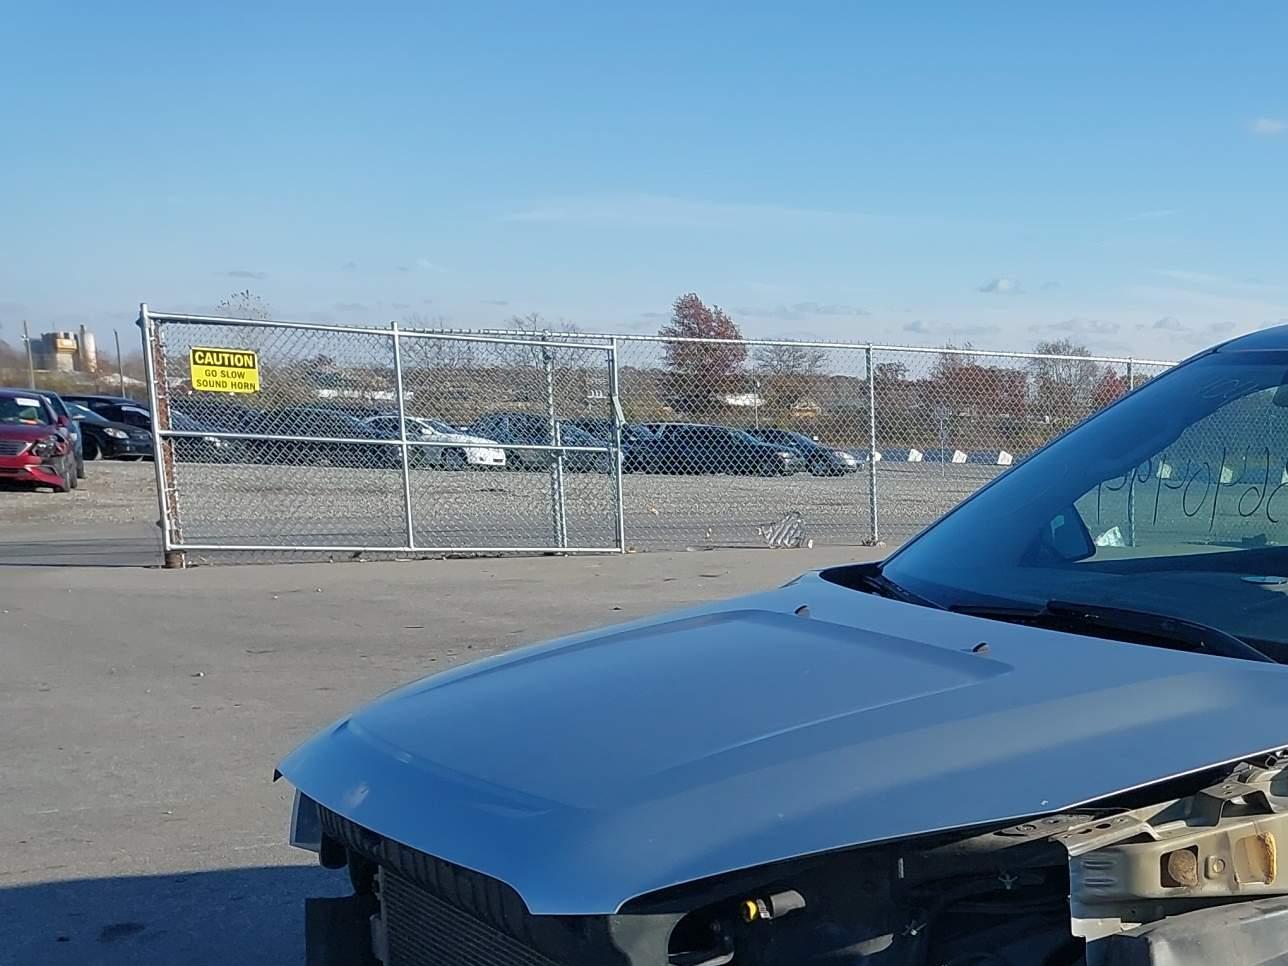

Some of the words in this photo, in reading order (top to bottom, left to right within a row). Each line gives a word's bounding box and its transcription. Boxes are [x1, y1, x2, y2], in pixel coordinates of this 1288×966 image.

[194, 351, 254, 367] CAUTION
[204, 369, 218, 378] GO
[220, 370, 246, 380] SLOW
[196, 379, 228, 389] SOUND
[231, 381, 256, 391] HORN
